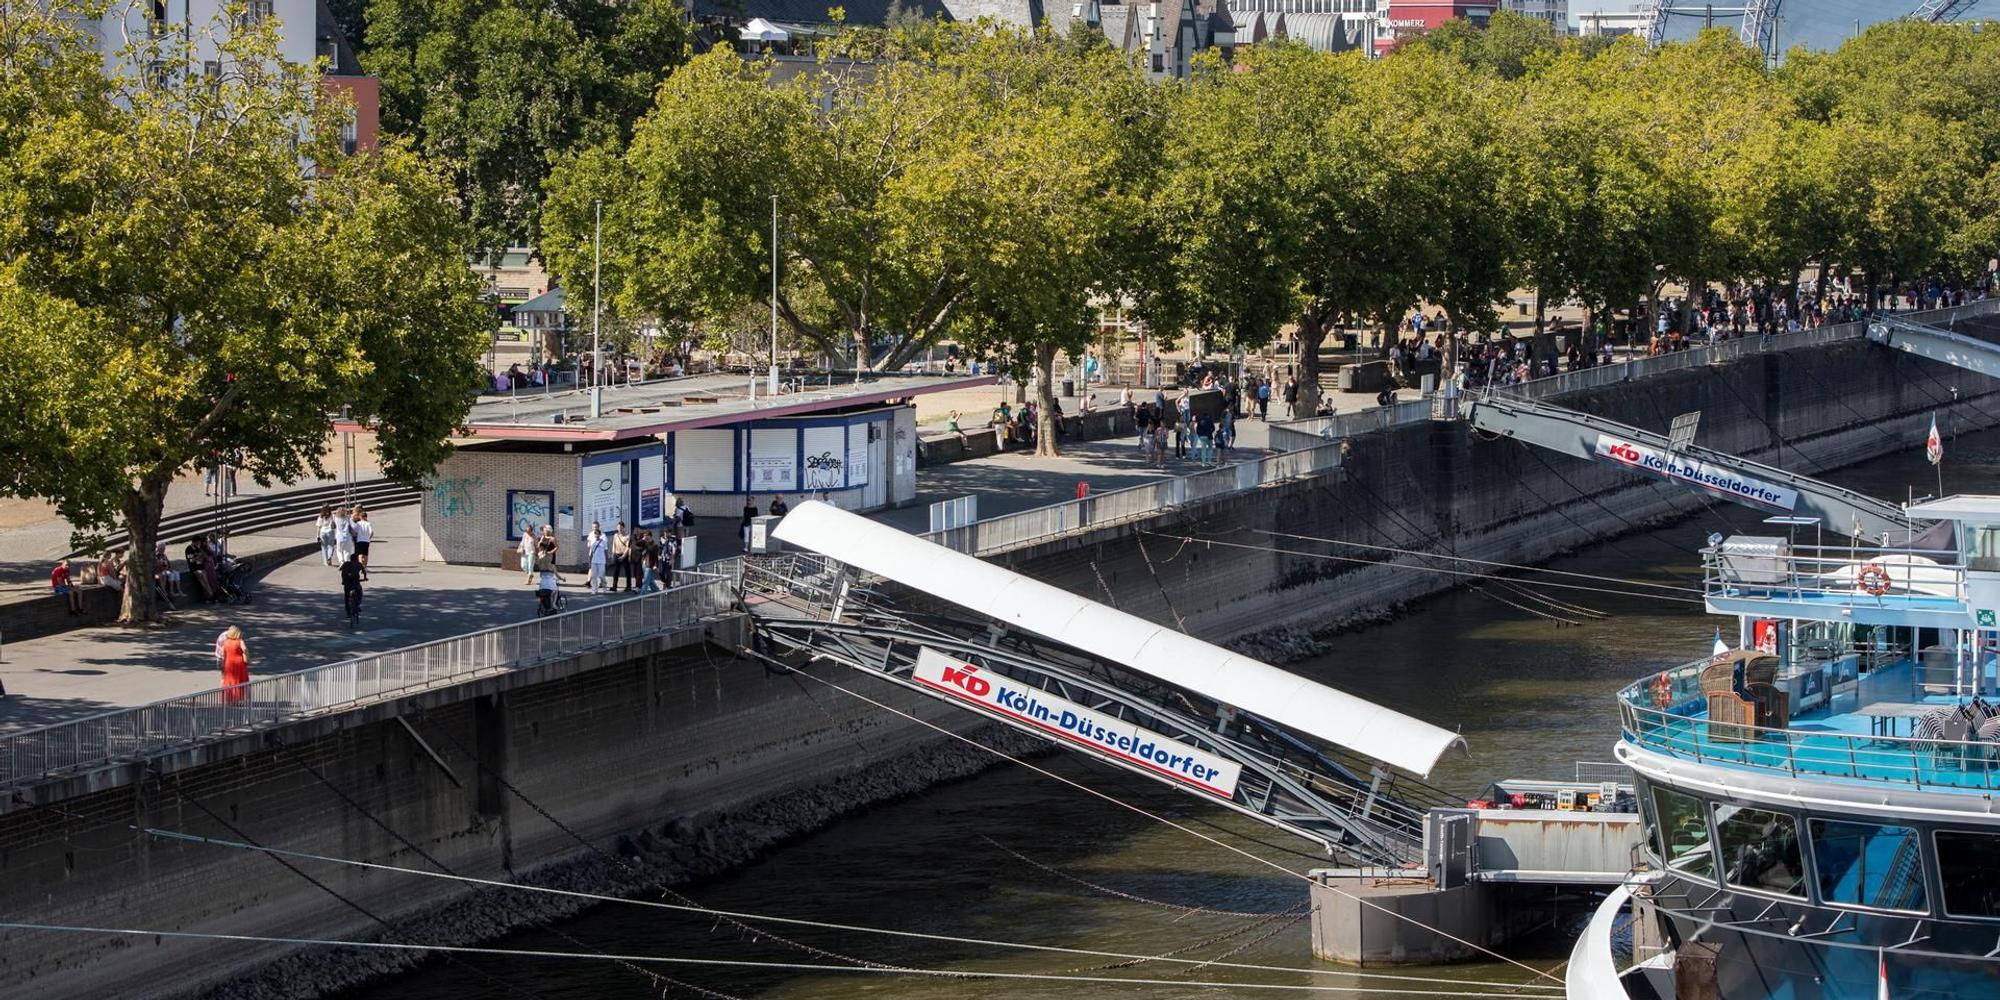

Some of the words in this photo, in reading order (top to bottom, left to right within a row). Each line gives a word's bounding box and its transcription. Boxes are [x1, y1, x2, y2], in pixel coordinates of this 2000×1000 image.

[1389, 19, 1425, 28] KOMMERZ
[1609, 443, 1640, 462] KD
[1643, 453, 1782, 503] Kön-Düsseldorfer
[941, 664, 991, 697] KD
[996, 686, 1220, 782] Köln-Düsseldorfer
